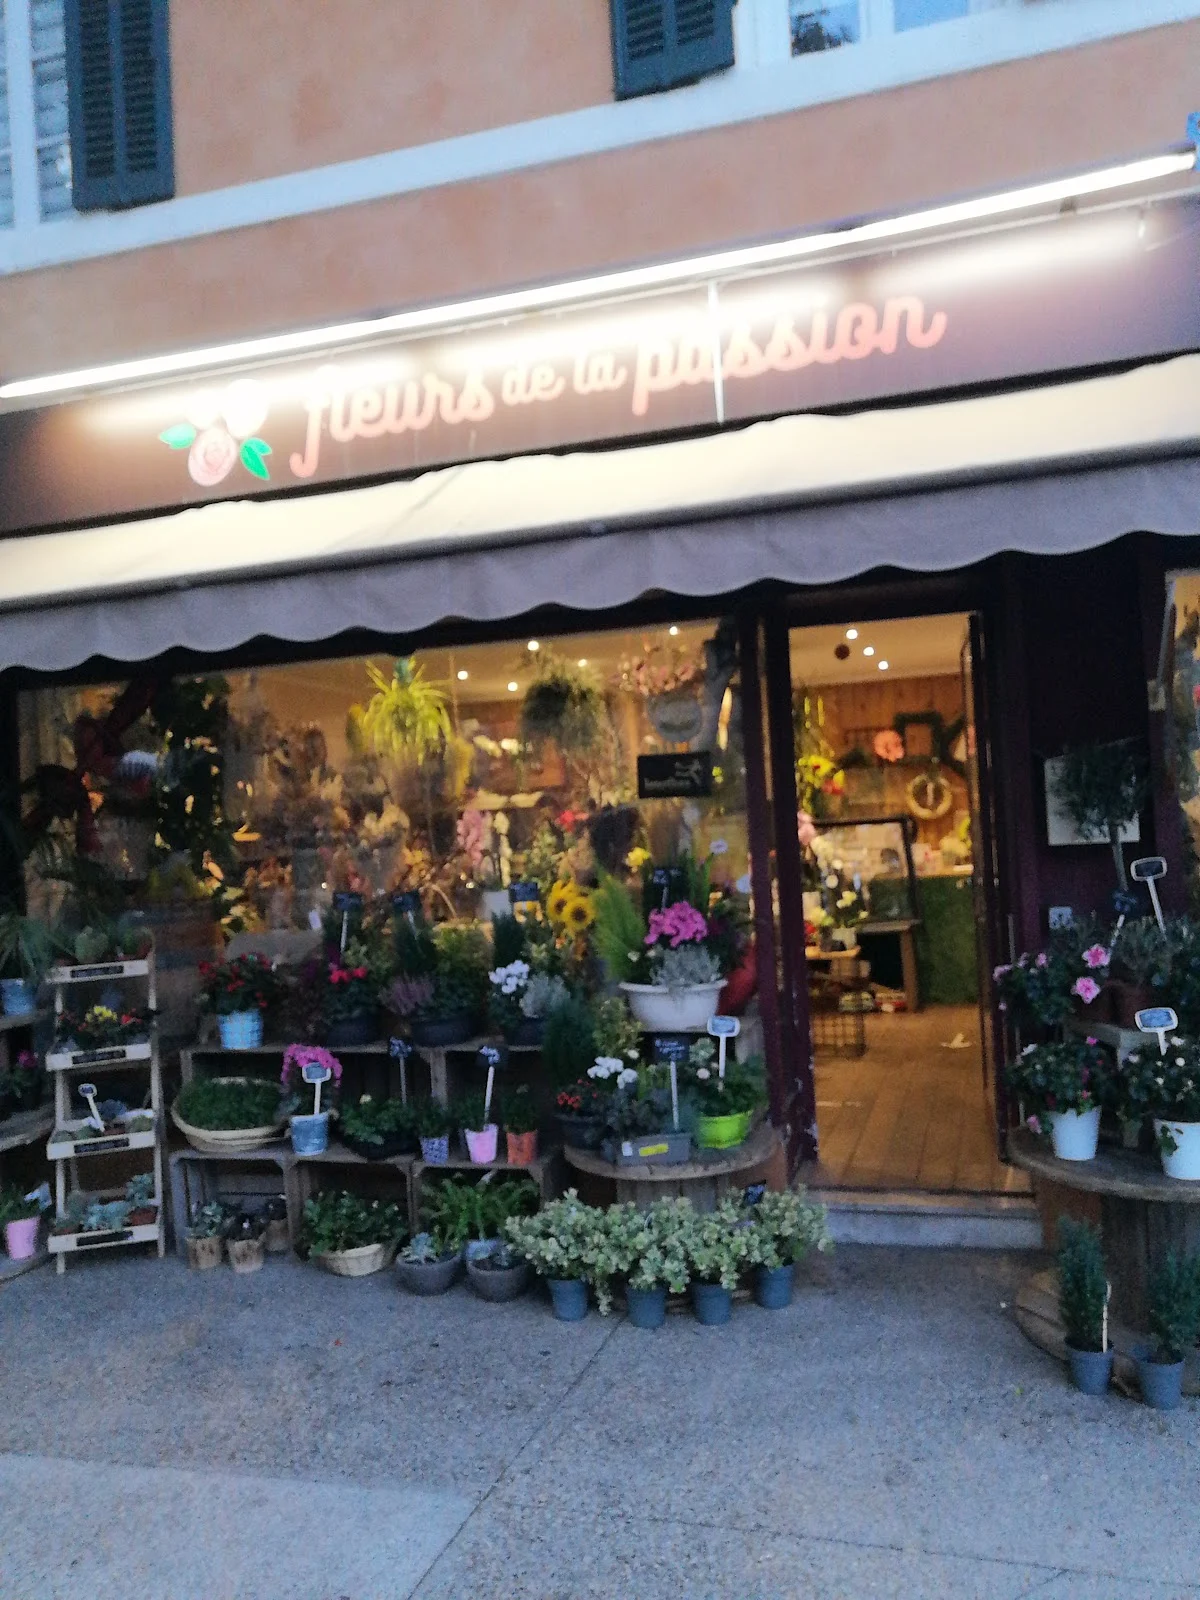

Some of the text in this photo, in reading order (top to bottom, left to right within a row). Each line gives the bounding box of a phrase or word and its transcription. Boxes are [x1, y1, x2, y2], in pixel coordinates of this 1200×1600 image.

[502, 362, 565, 406] de
[573, 348, 627, 394] la
[632, 296, 948, 416] passion
